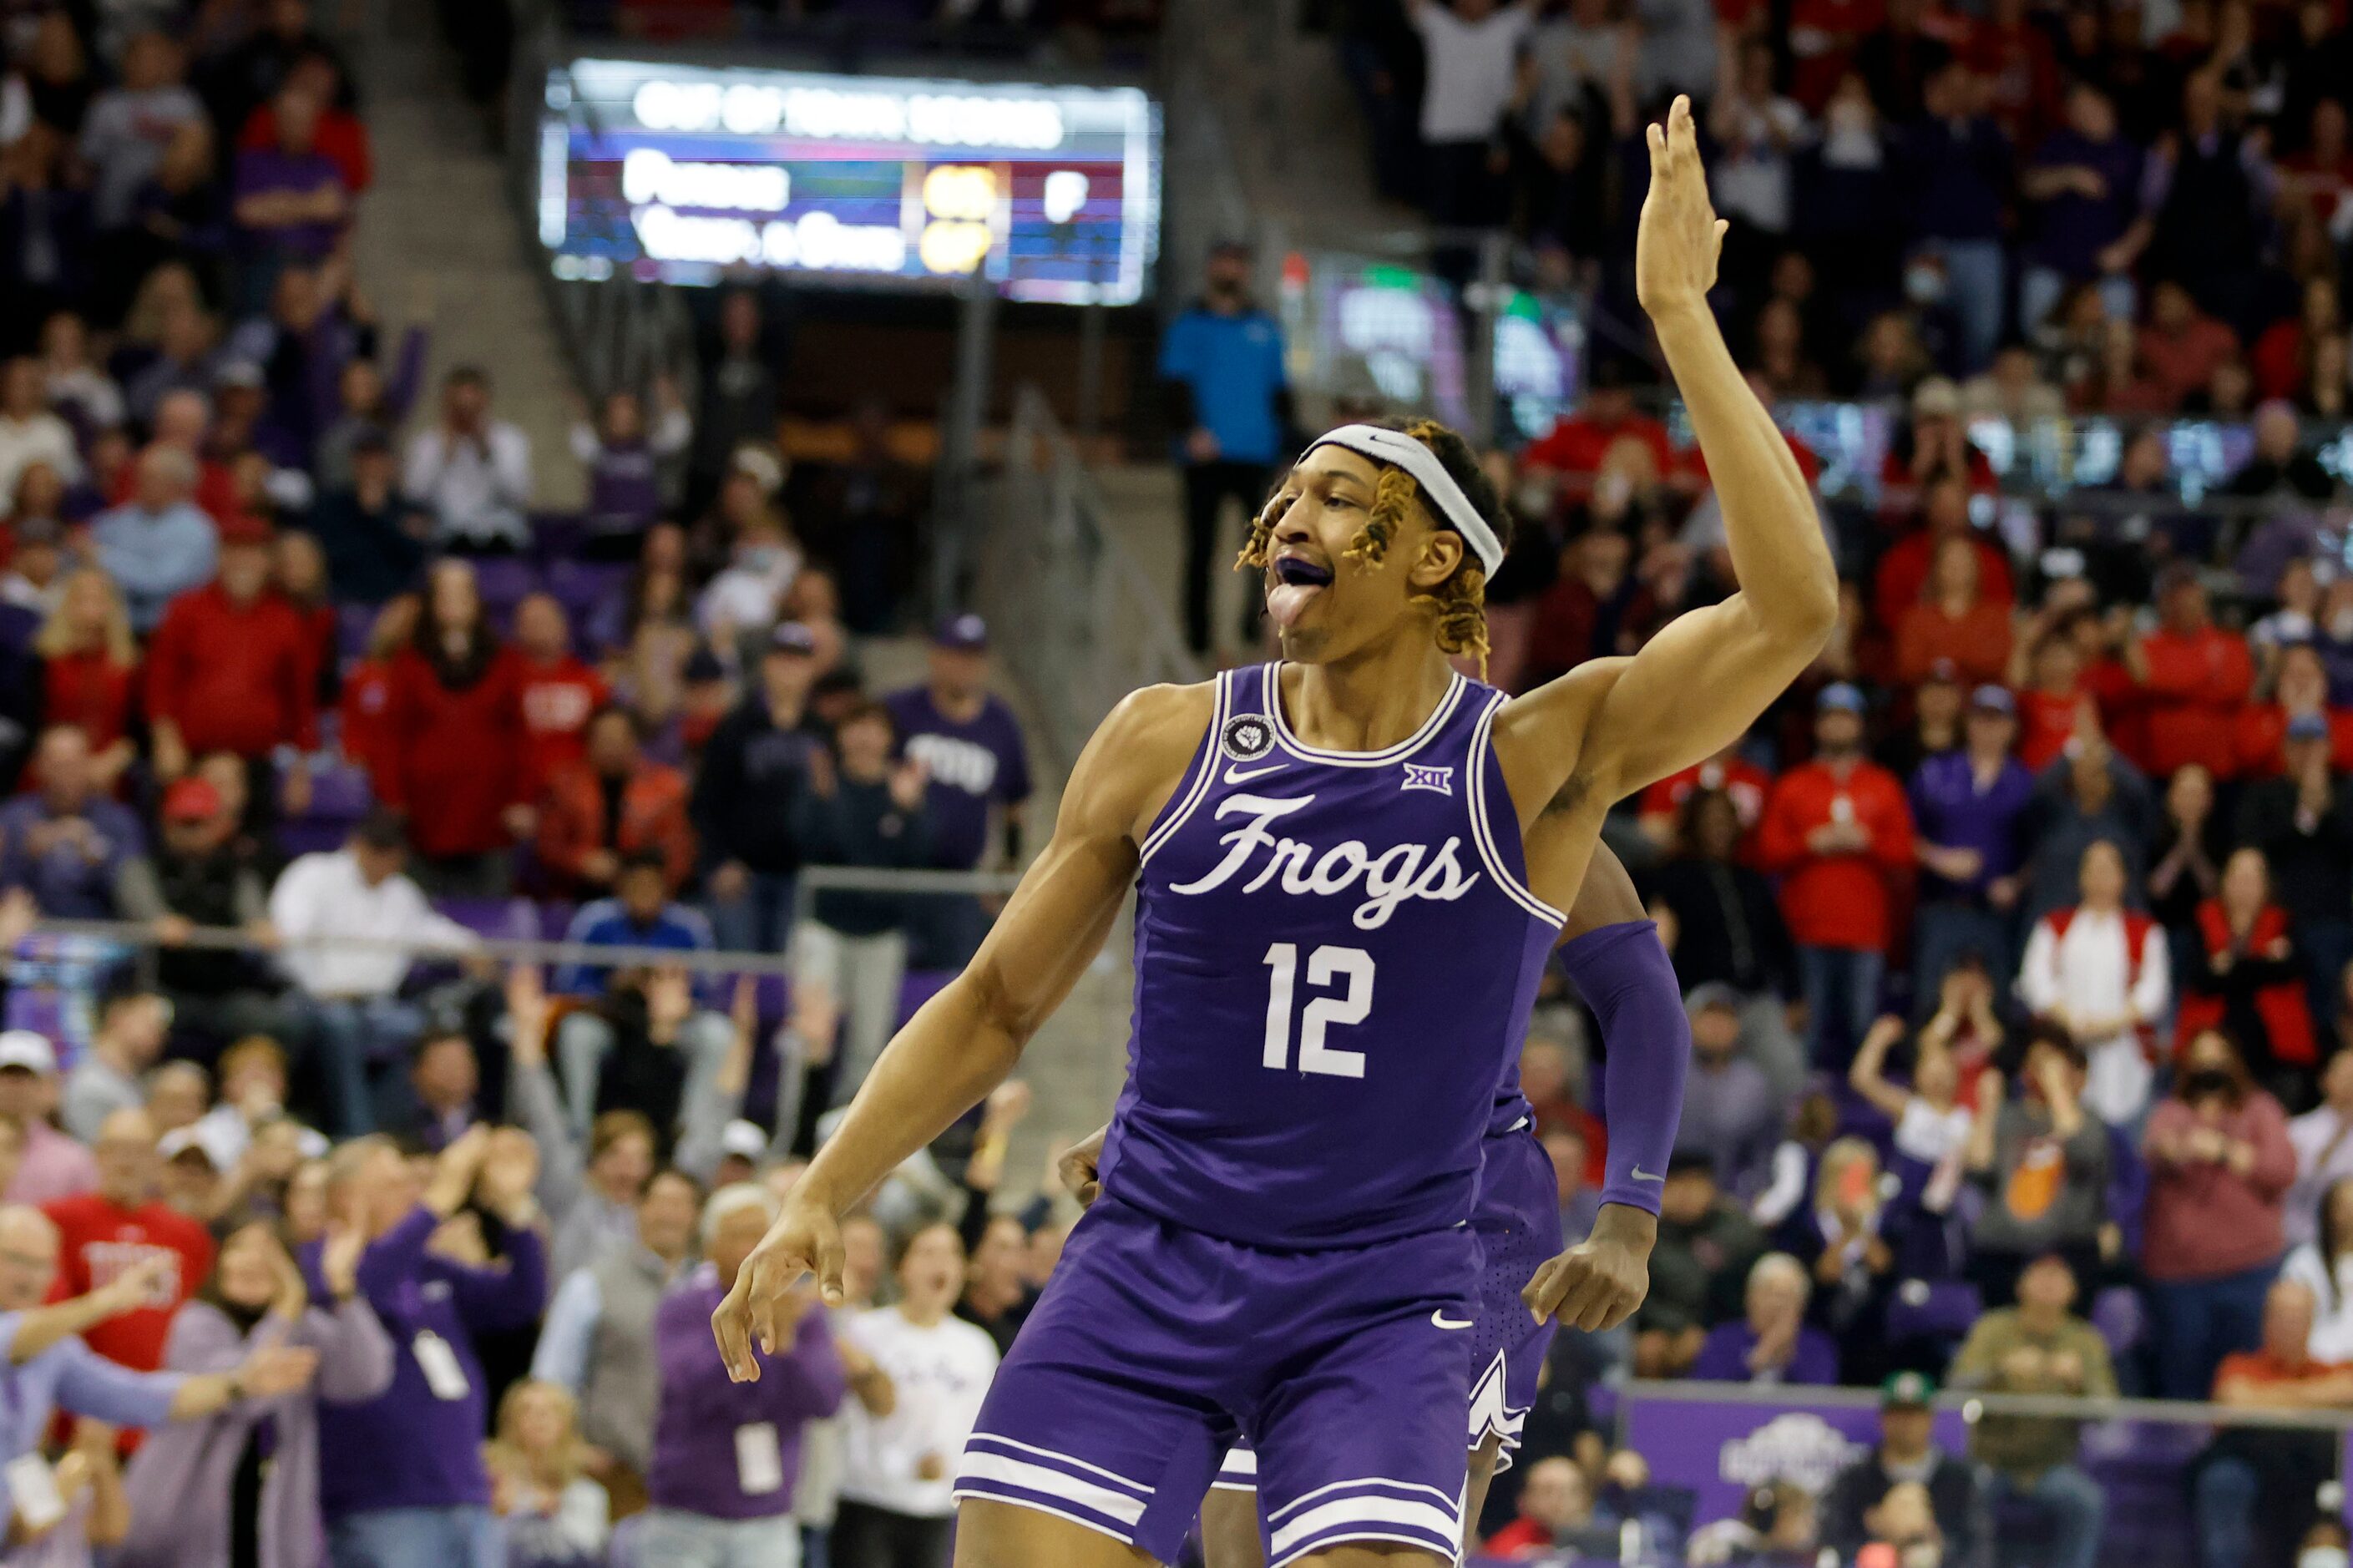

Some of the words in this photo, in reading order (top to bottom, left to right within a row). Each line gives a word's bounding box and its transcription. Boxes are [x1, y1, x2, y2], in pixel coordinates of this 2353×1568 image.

[1409, 767, 1448, 790] XII
[1169, 793, 1480, 930] Frogs
[1263, 942, 1376, 1079] 12
